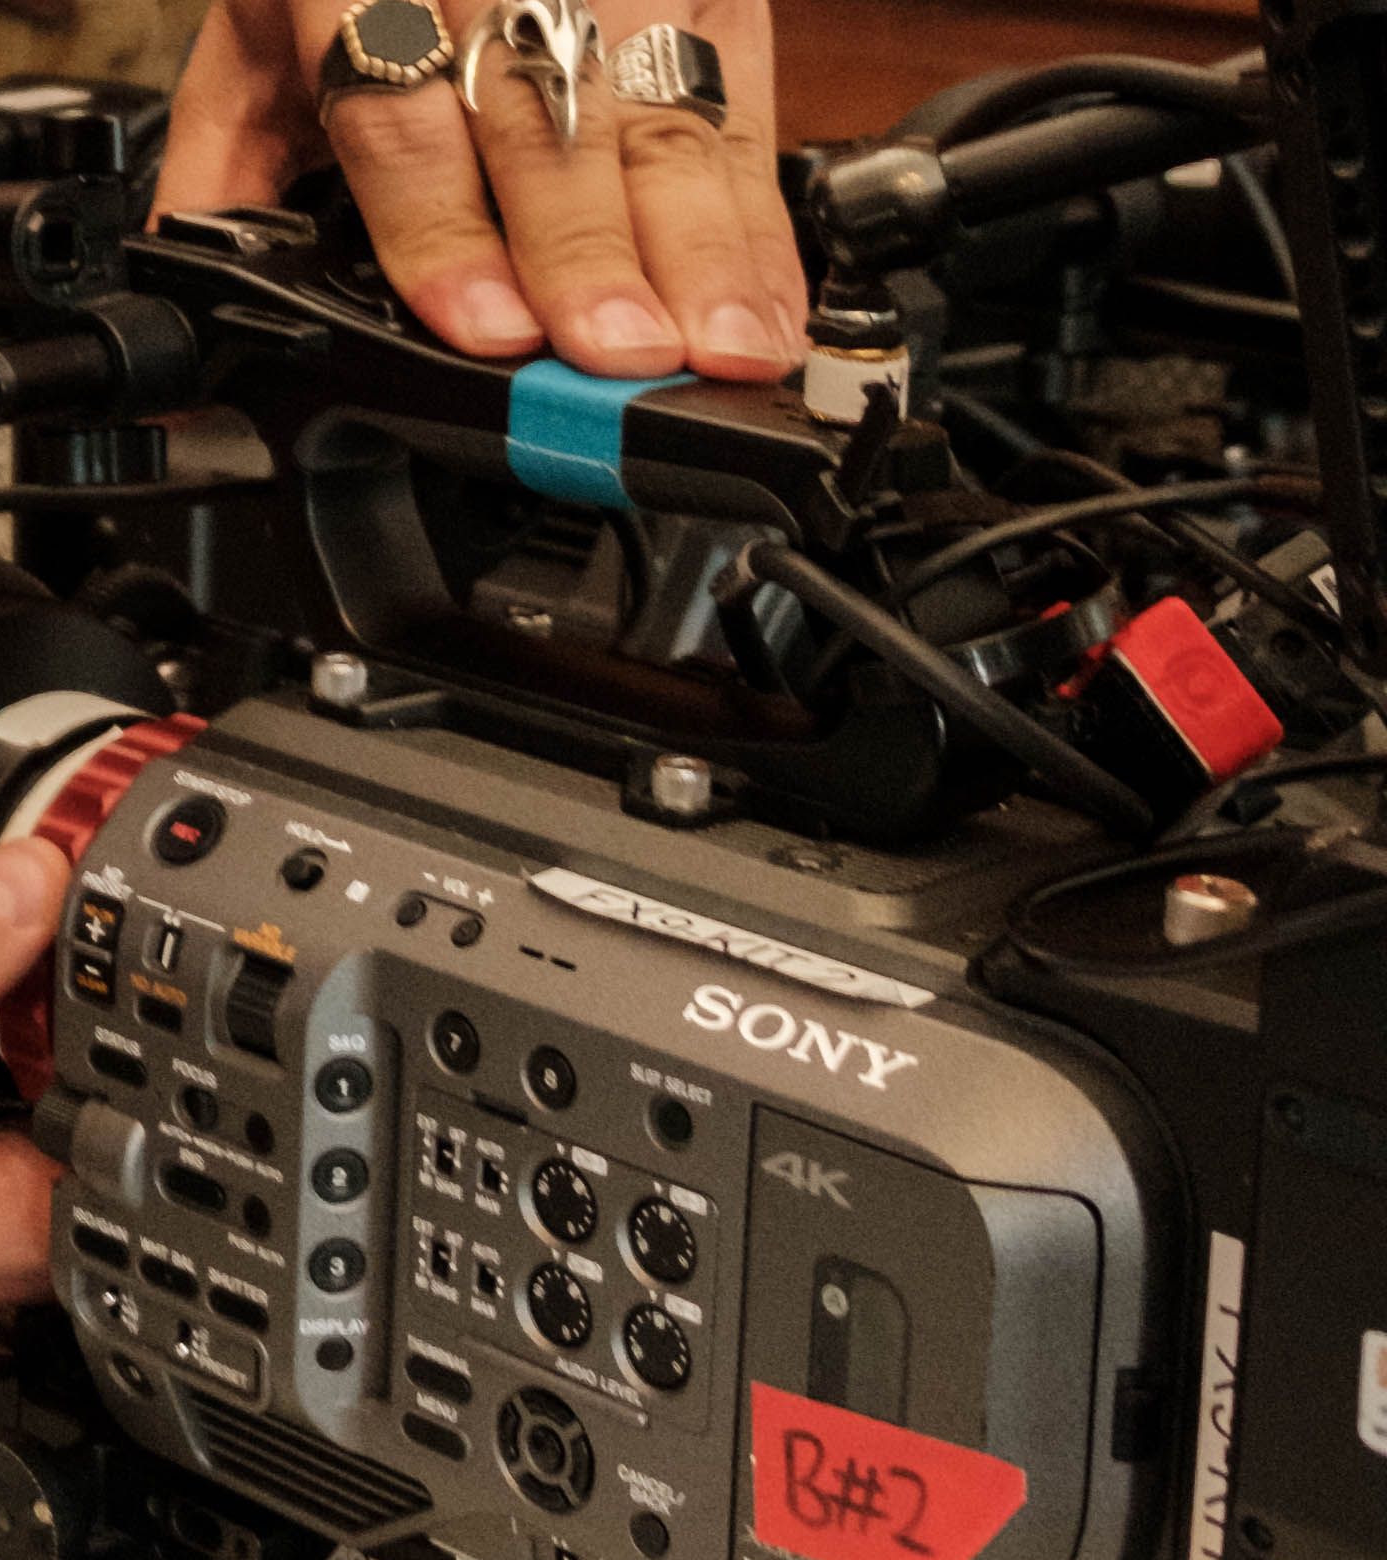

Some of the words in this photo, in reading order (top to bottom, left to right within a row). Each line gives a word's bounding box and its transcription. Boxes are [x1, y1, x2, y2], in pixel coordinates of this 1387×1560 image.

[682, 984, 919, 1091] SONY
[337, 1076, 350, 1098] 1
[664, 1067, 712, 1106] SELECT
[332, 1166, 347, 1189] 2
[761, 1151, 853, 1210] 4K
[329, 1256, 346, 1278] 3
[299, 1317, 369, 1337] DISPLAY
[555, 1357, 597, 1387] AUDIO
[598, 1375, 644, 1408] LEVEL
[417, 1391, 458, 1423] MENU
[782, 1429, 933, 1557] B#2
